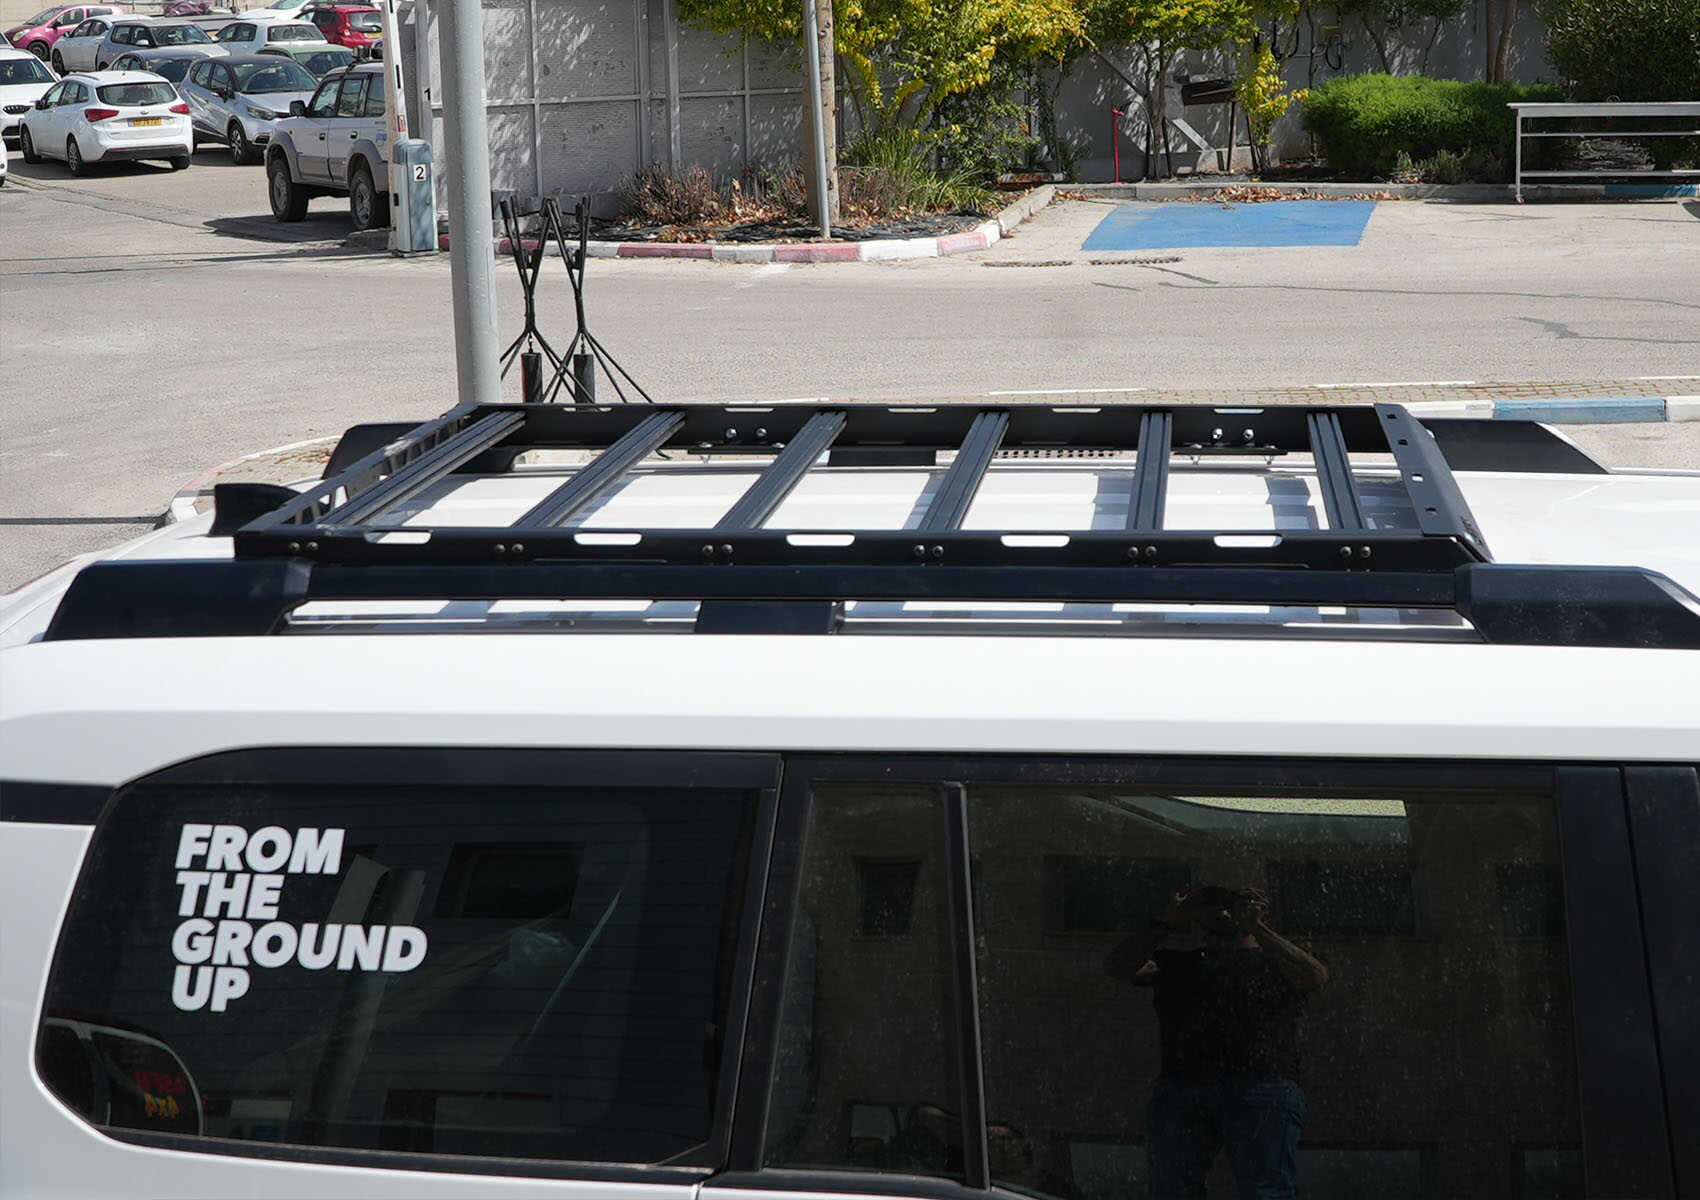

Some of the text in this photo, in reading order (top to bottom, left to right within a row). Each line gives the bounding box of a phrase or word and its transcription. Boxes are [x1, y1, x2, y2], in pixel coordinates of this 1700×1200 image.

[415, 166, 424, 180] 2
[175, 823, 345, 874] FROM
[176, 870, 285, 920] THE
[171, 918, 428, 972] GROUND
[171, 965, 250, 1012] UP
